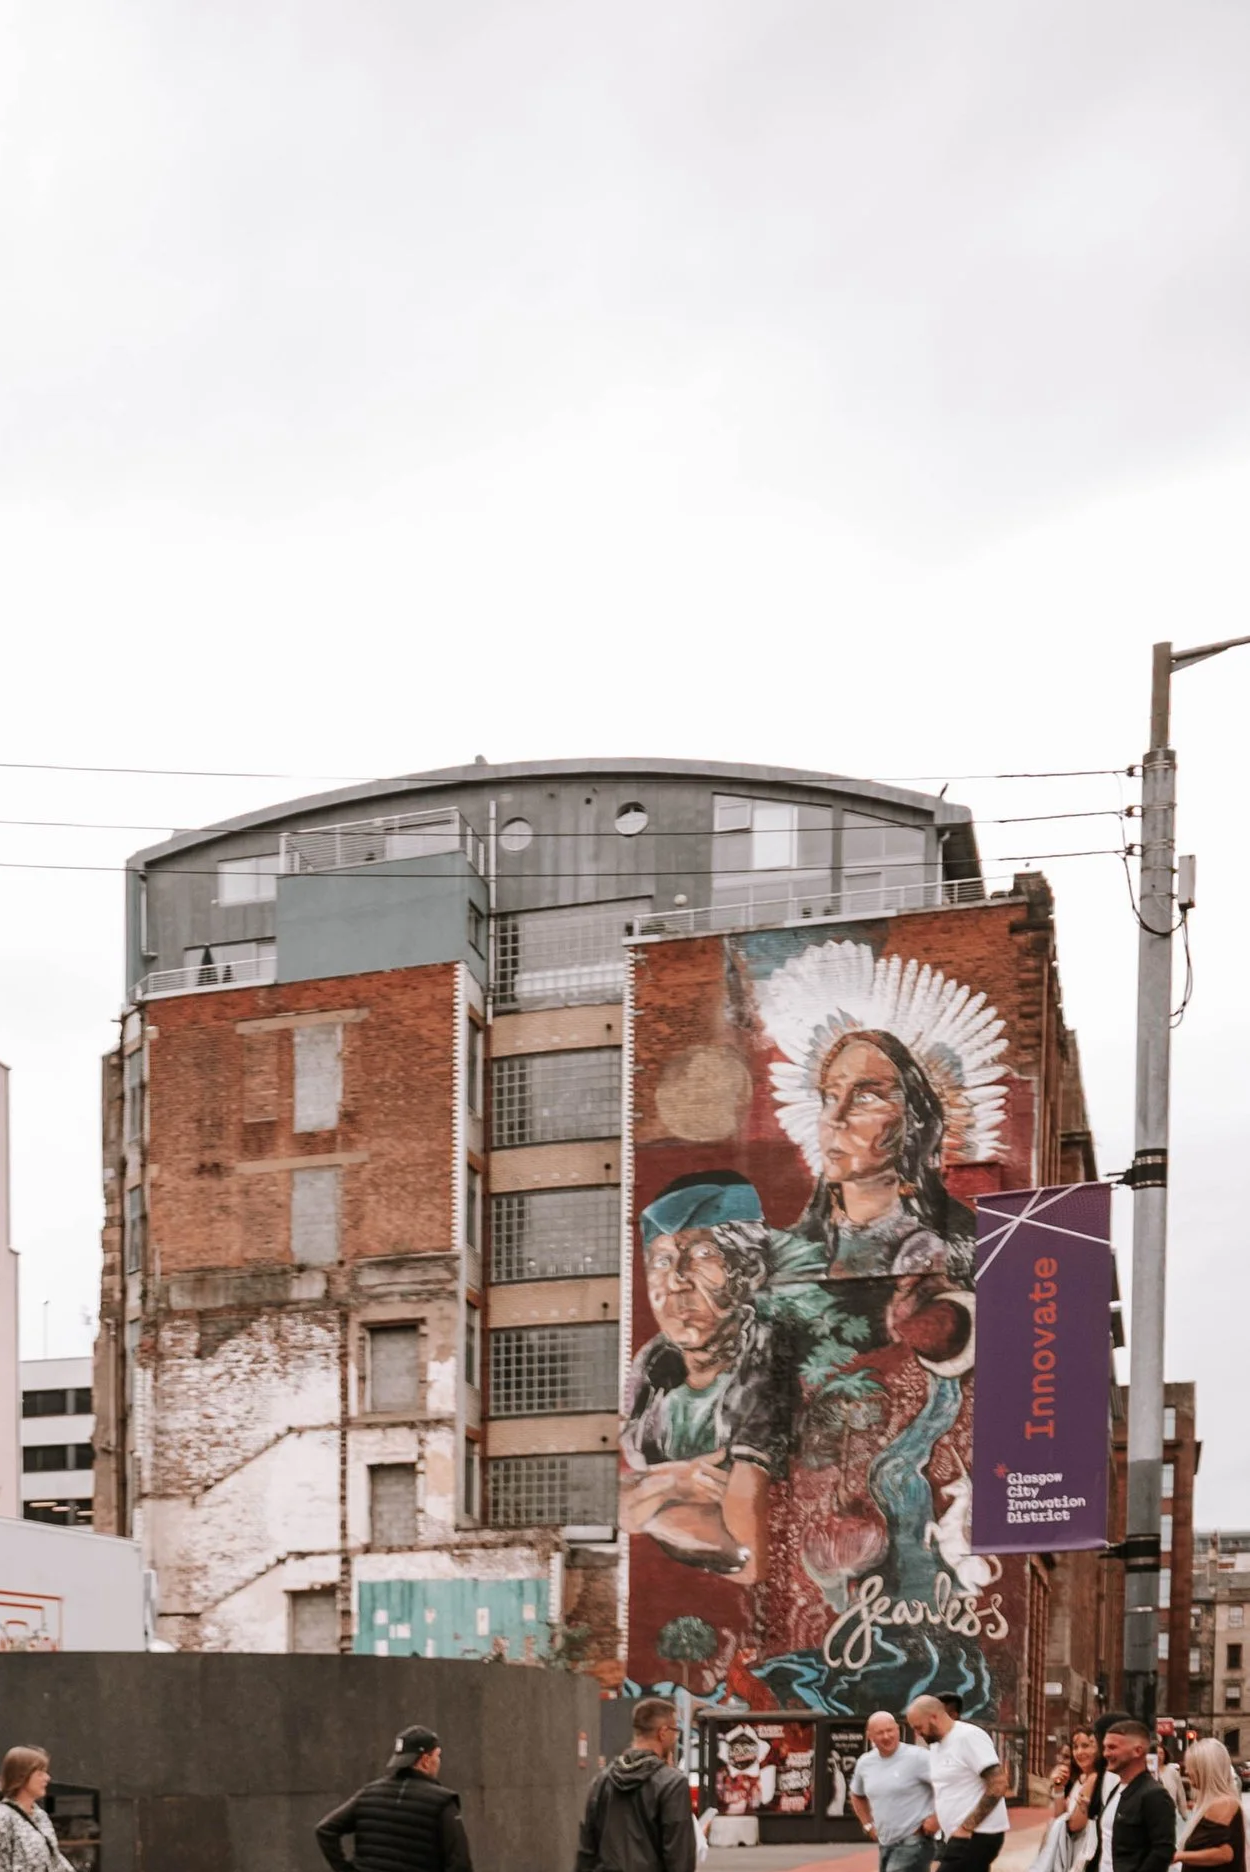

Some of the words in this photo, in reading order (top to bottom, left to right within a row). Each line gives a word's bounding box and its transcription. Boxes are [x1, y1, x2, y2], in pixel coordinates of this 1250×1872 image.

[1024, 1256, 1059, 1441] Innovate
[1007, 1472, 1063, 1486] Glasgow
[1006, 1485, 1040, 1498] City
[1007, 1495, 1086, 1511] Innovation
[1007, 1508, 1071, 1524] District
